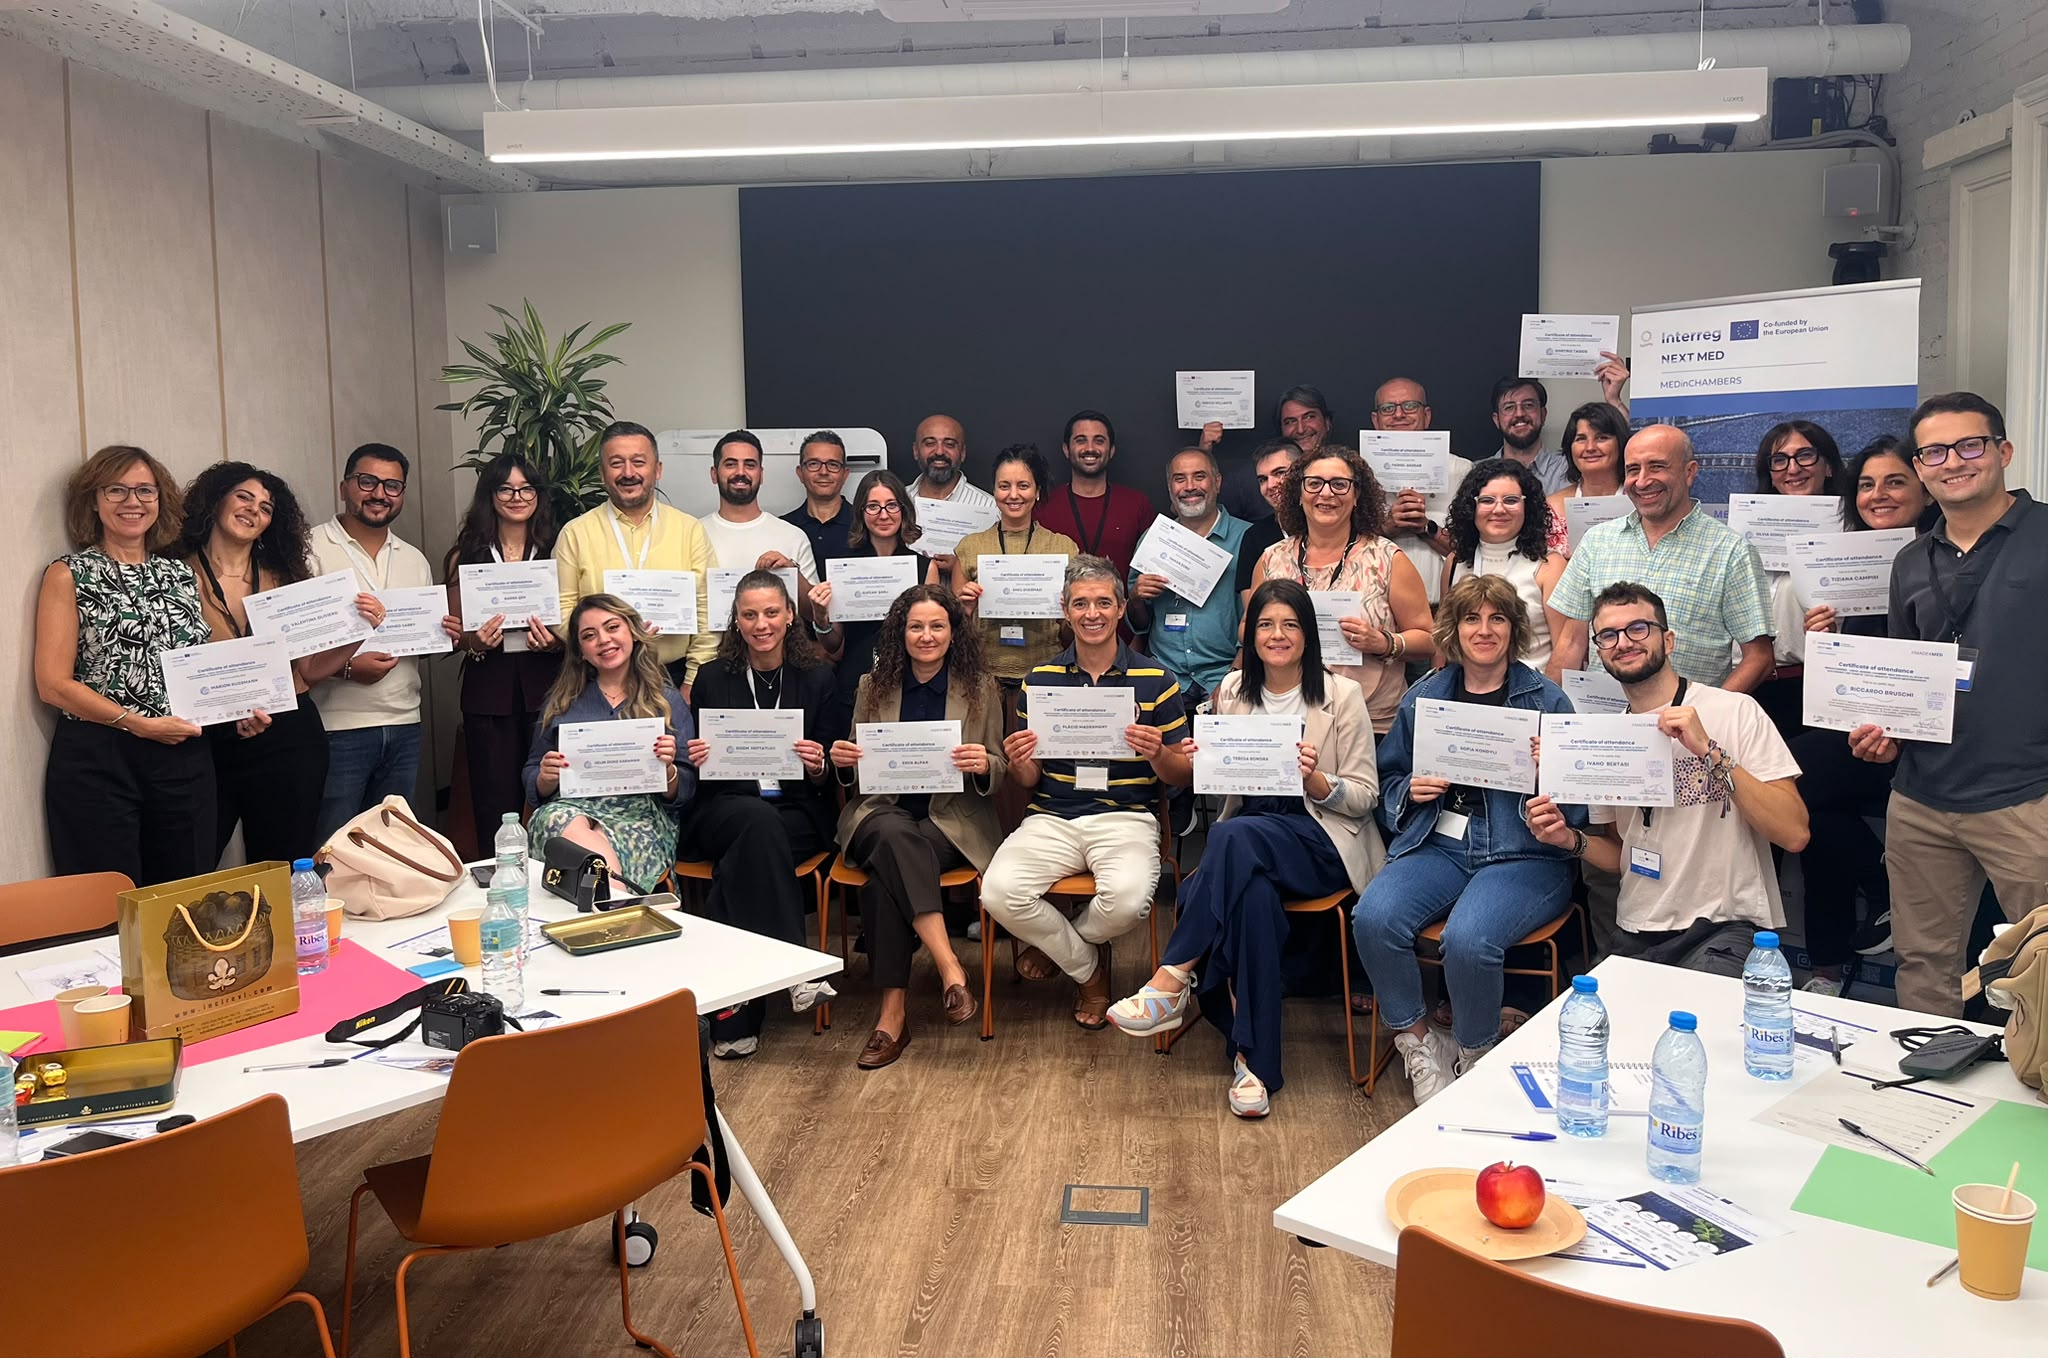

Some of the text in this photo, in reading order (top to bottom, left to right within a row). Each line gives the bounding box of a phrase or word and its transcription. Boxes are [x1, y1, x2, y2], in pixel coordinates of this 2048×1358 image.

[1763, 319, 1798, 328] Co-funded
[1662, 330, 1721, 345] Interreg
[1775, 327, 1807, 336] European
[1662, 350, 1725, 365] NEXT MED
[1660, 376, 1742, 389] MEDinCHAMBERS
[1838, 662, 1869, 670] Certificate
[1877, 666, 1914, 674] attendance
[1850, 686, 1883, 695] RICCARDO
[300, 935, 324, 945] Ribes
[1752, 1028, 1784, 1042] Ribes
[1660, 1122, 1697, 1140] Ribes
